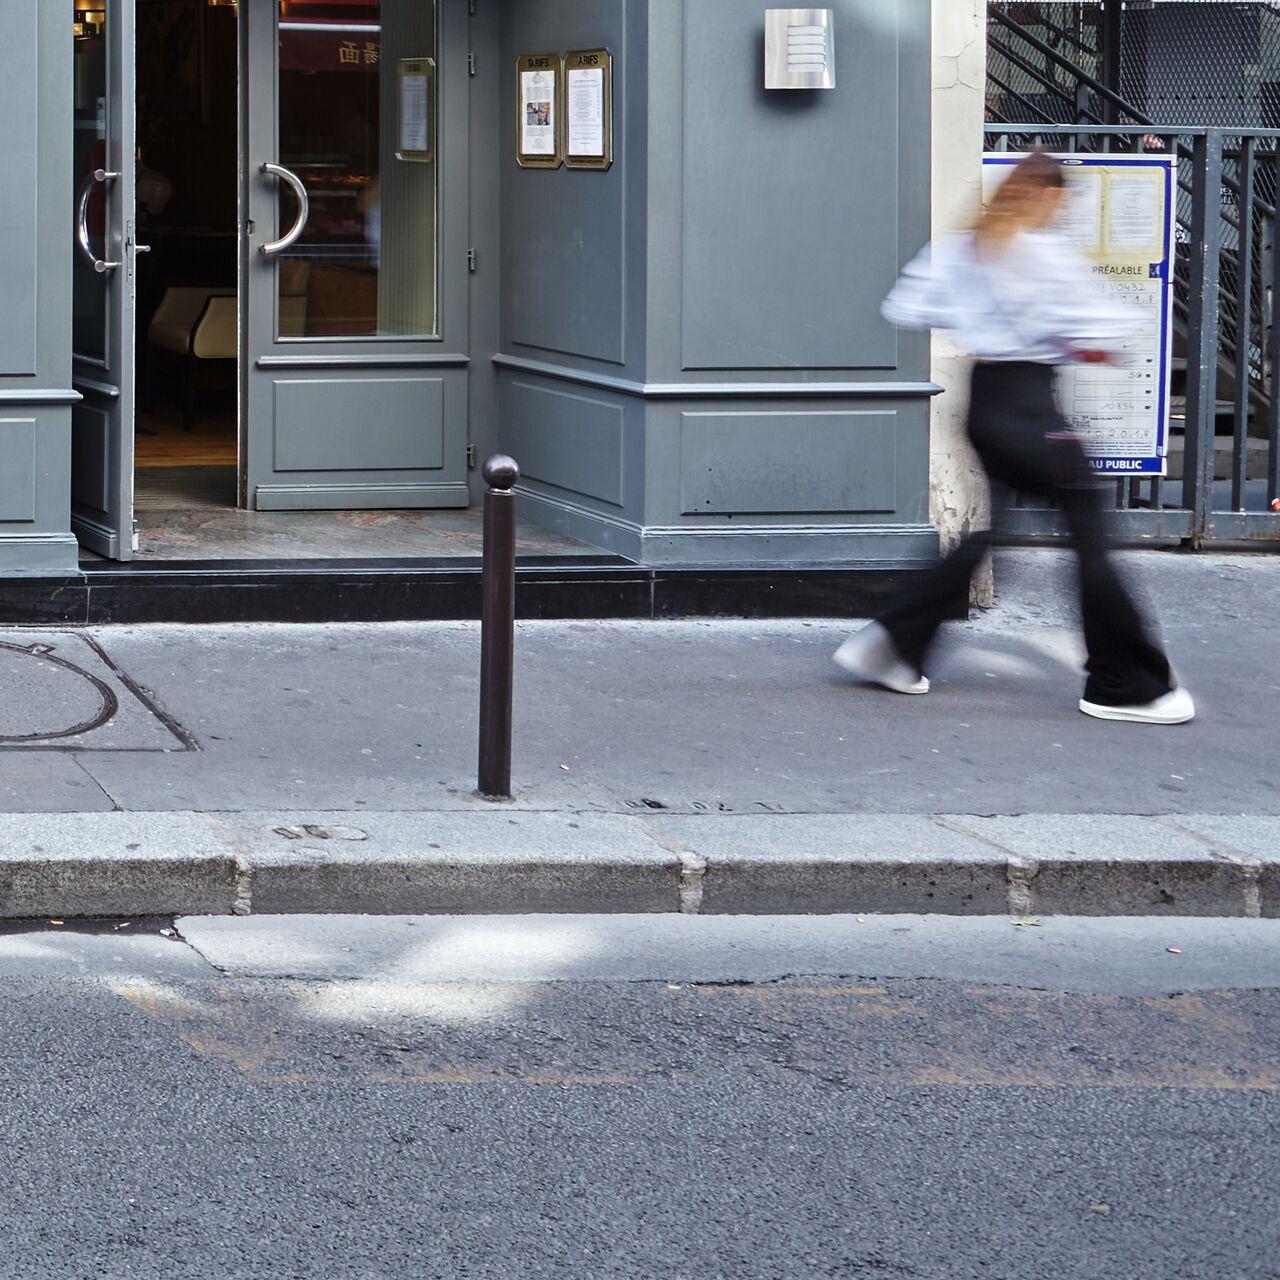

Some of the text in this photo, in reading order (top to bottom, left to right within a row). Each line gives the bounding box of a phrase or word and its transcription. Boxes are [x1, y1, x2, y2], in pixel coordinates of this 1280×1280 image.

[1092, 264, 1143, 275] PRÉALABLE
[1088, 460, 1142, 469] AU PUBLIC
